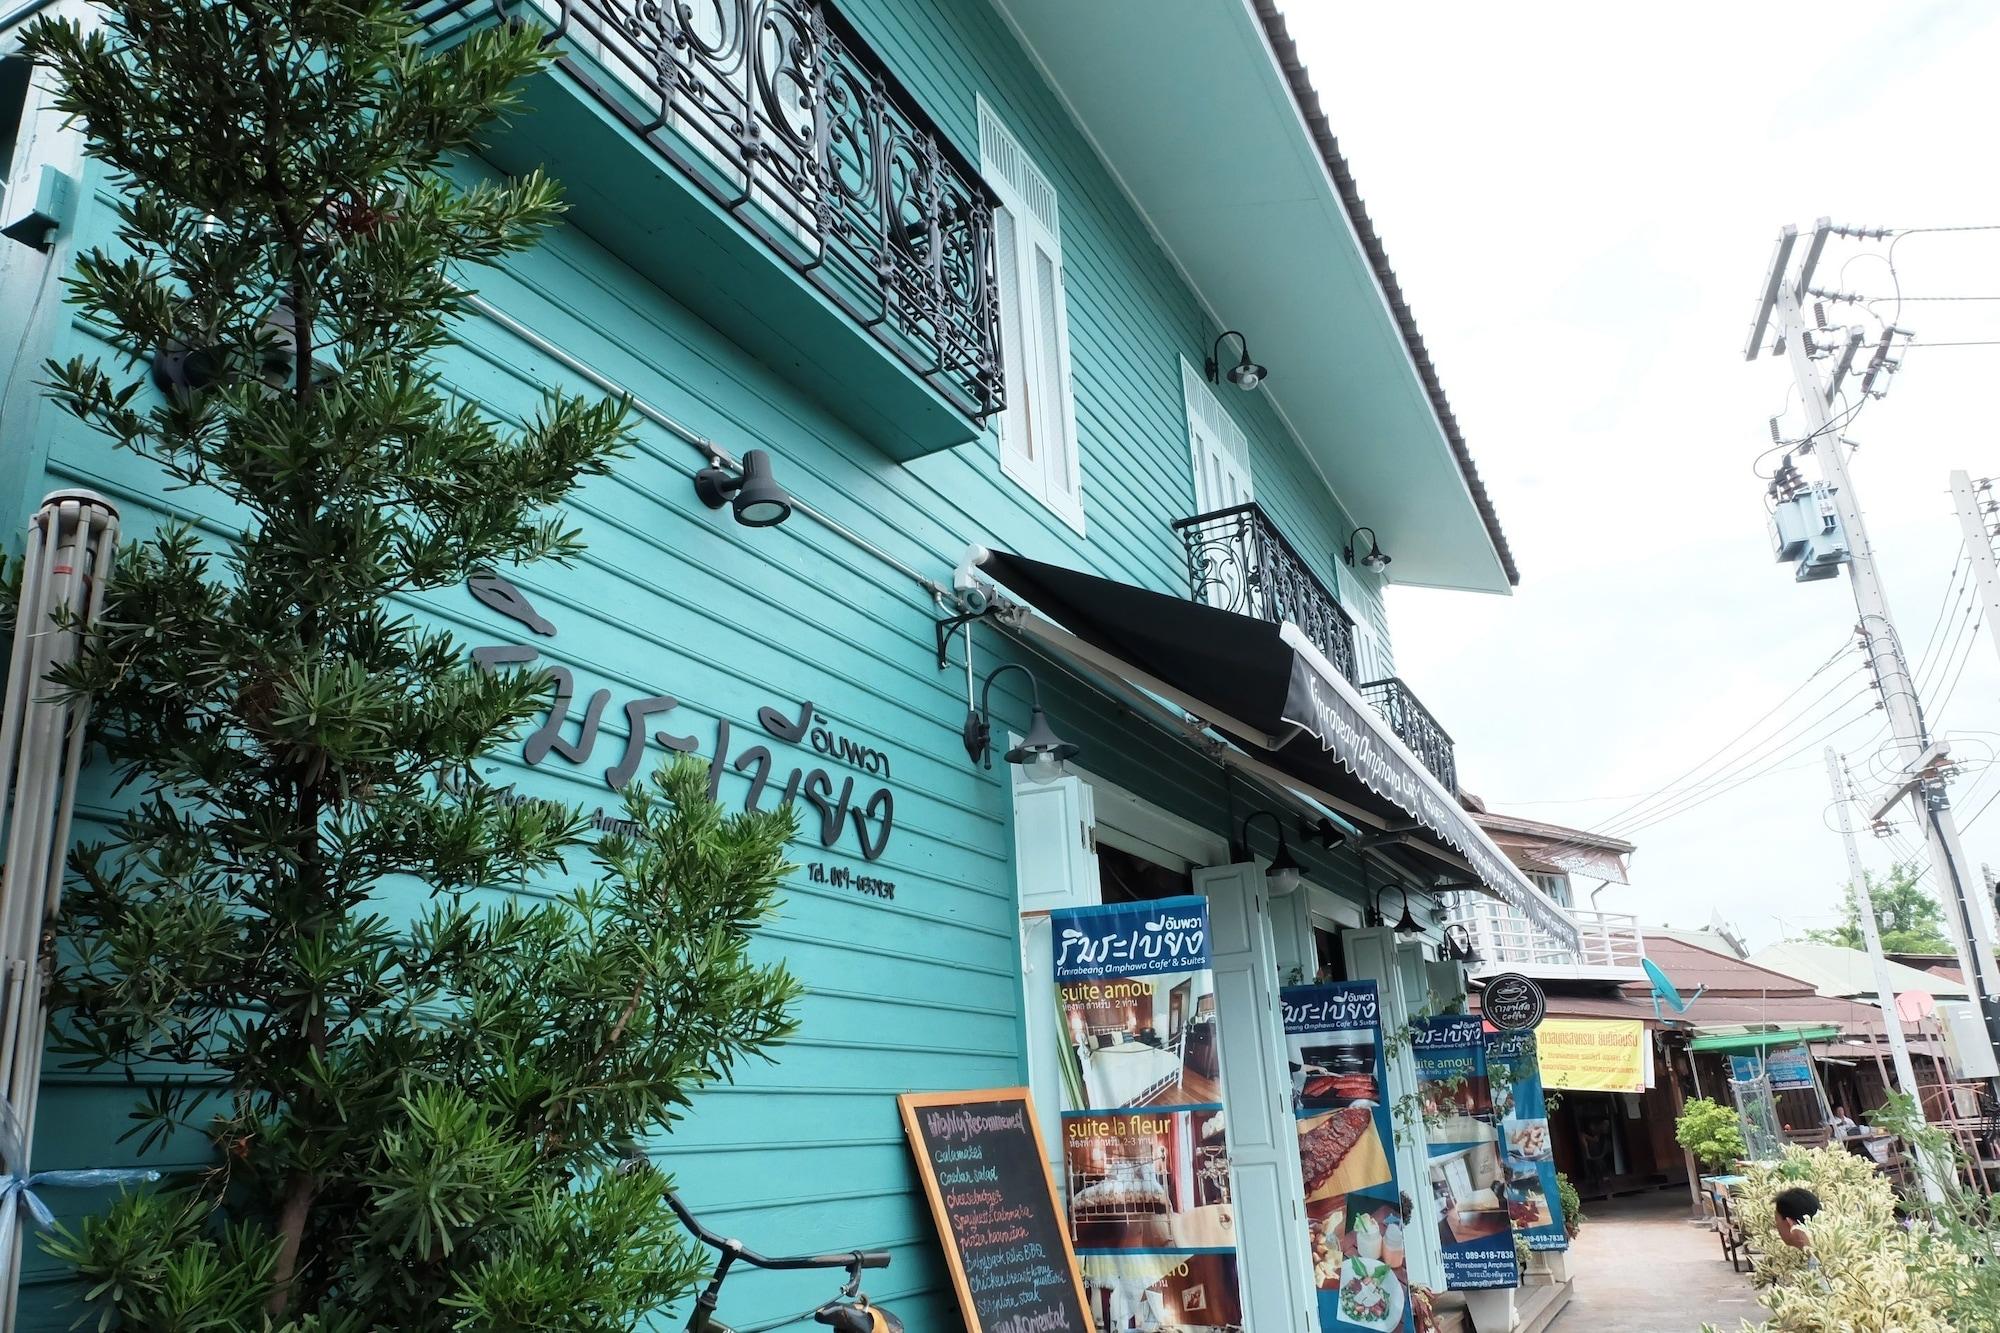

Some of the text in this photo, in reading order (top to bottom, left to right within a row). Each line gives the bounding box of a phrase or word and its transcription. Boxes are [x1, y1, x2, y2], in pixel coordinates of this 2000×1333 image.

[811, 714, 890, 778] อัมพวา
[1165, 916, 1202, 930] อัมพวา
[1056, 914, 1204, 966] ริมระเบียง
[1172, 958, 1179, 967] &
[1181, 956, 1206, 967] Suites
[1062, 981, 1157, 1002] suite amour
[1115, 1000, 1120, 1008] 2
[1415, 1057, 1435, 1069] uite
[1069, 1115, 1171, 1138] suite la fleur
[1024, 1243, 1046, 1260] BBQ
[1465, 1250, 1514, 1260] 089-618-7838
